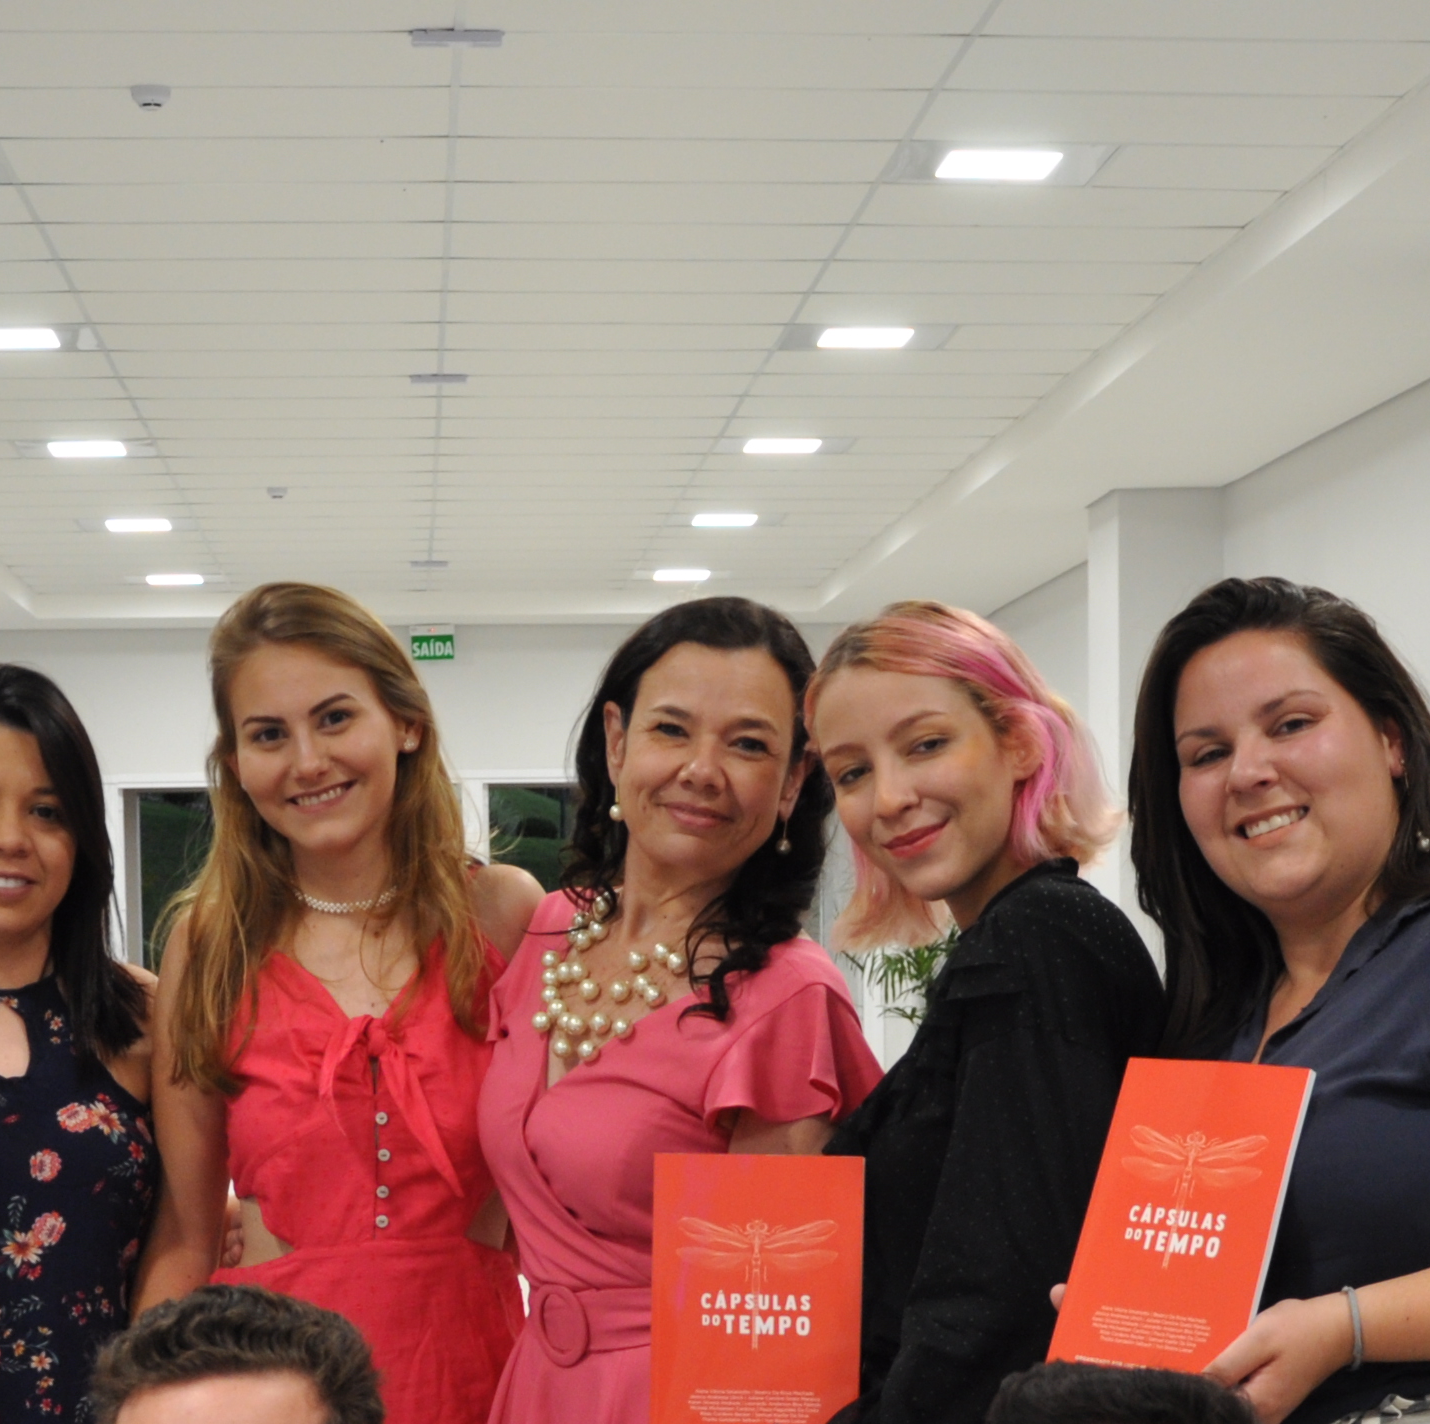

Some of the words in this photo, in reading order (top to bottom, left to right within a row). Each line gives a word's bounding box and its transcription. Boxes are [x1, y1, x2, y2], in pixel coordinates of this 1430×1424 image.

[412, 638, 453, 657] SAÍDA
[1129, 1202, 1227, 1232] CÁPSULAS
[1124, 1227, 1143, 1241] DO
[1143, 1228, 1221, 1259] TEMPO
[700, 1289, 811, 1311] CÁPSULAS
[701, 1313, 722, 1327] DO
[723, 1313, 811, 1336] TEMPO
